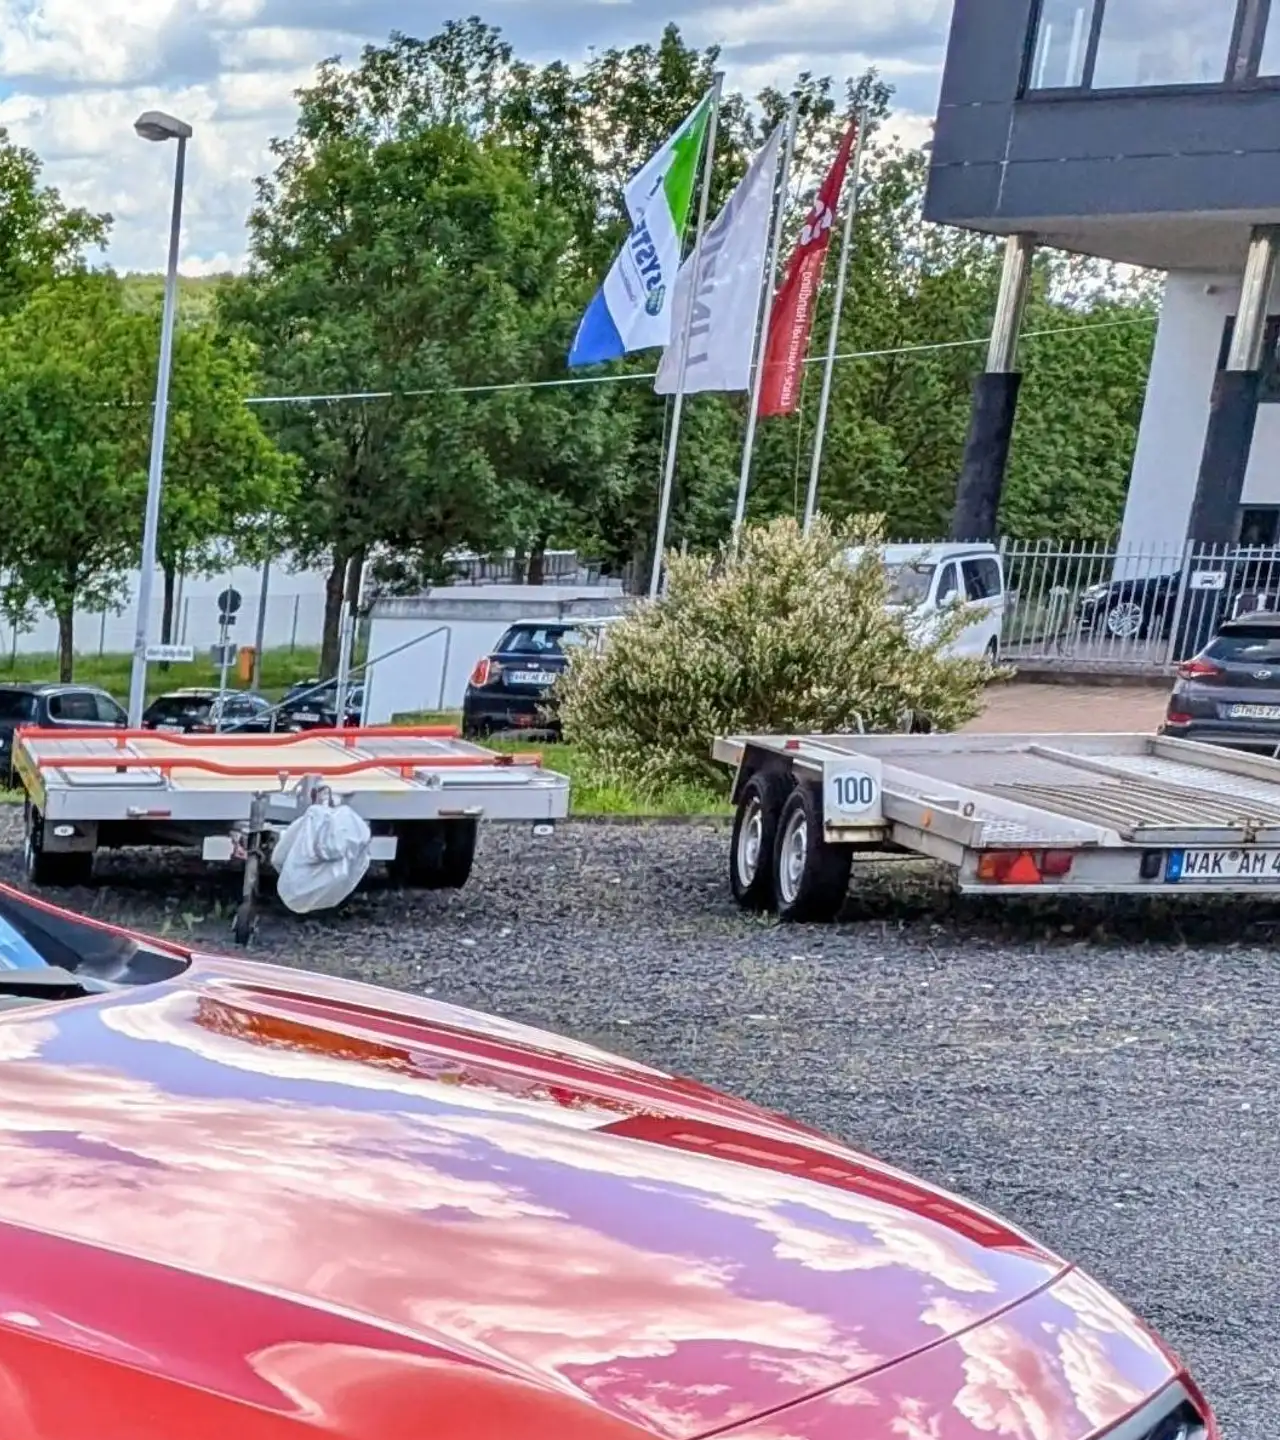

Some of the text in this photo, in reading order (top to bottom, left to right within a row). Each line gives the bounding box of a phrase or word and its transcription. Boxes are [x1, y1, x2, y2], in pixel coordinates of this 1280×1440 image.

[834, 777, 872, 804] 100
[1185, 852, 1226, 873] WAK
[1238, 852, 1267, 873] AM
